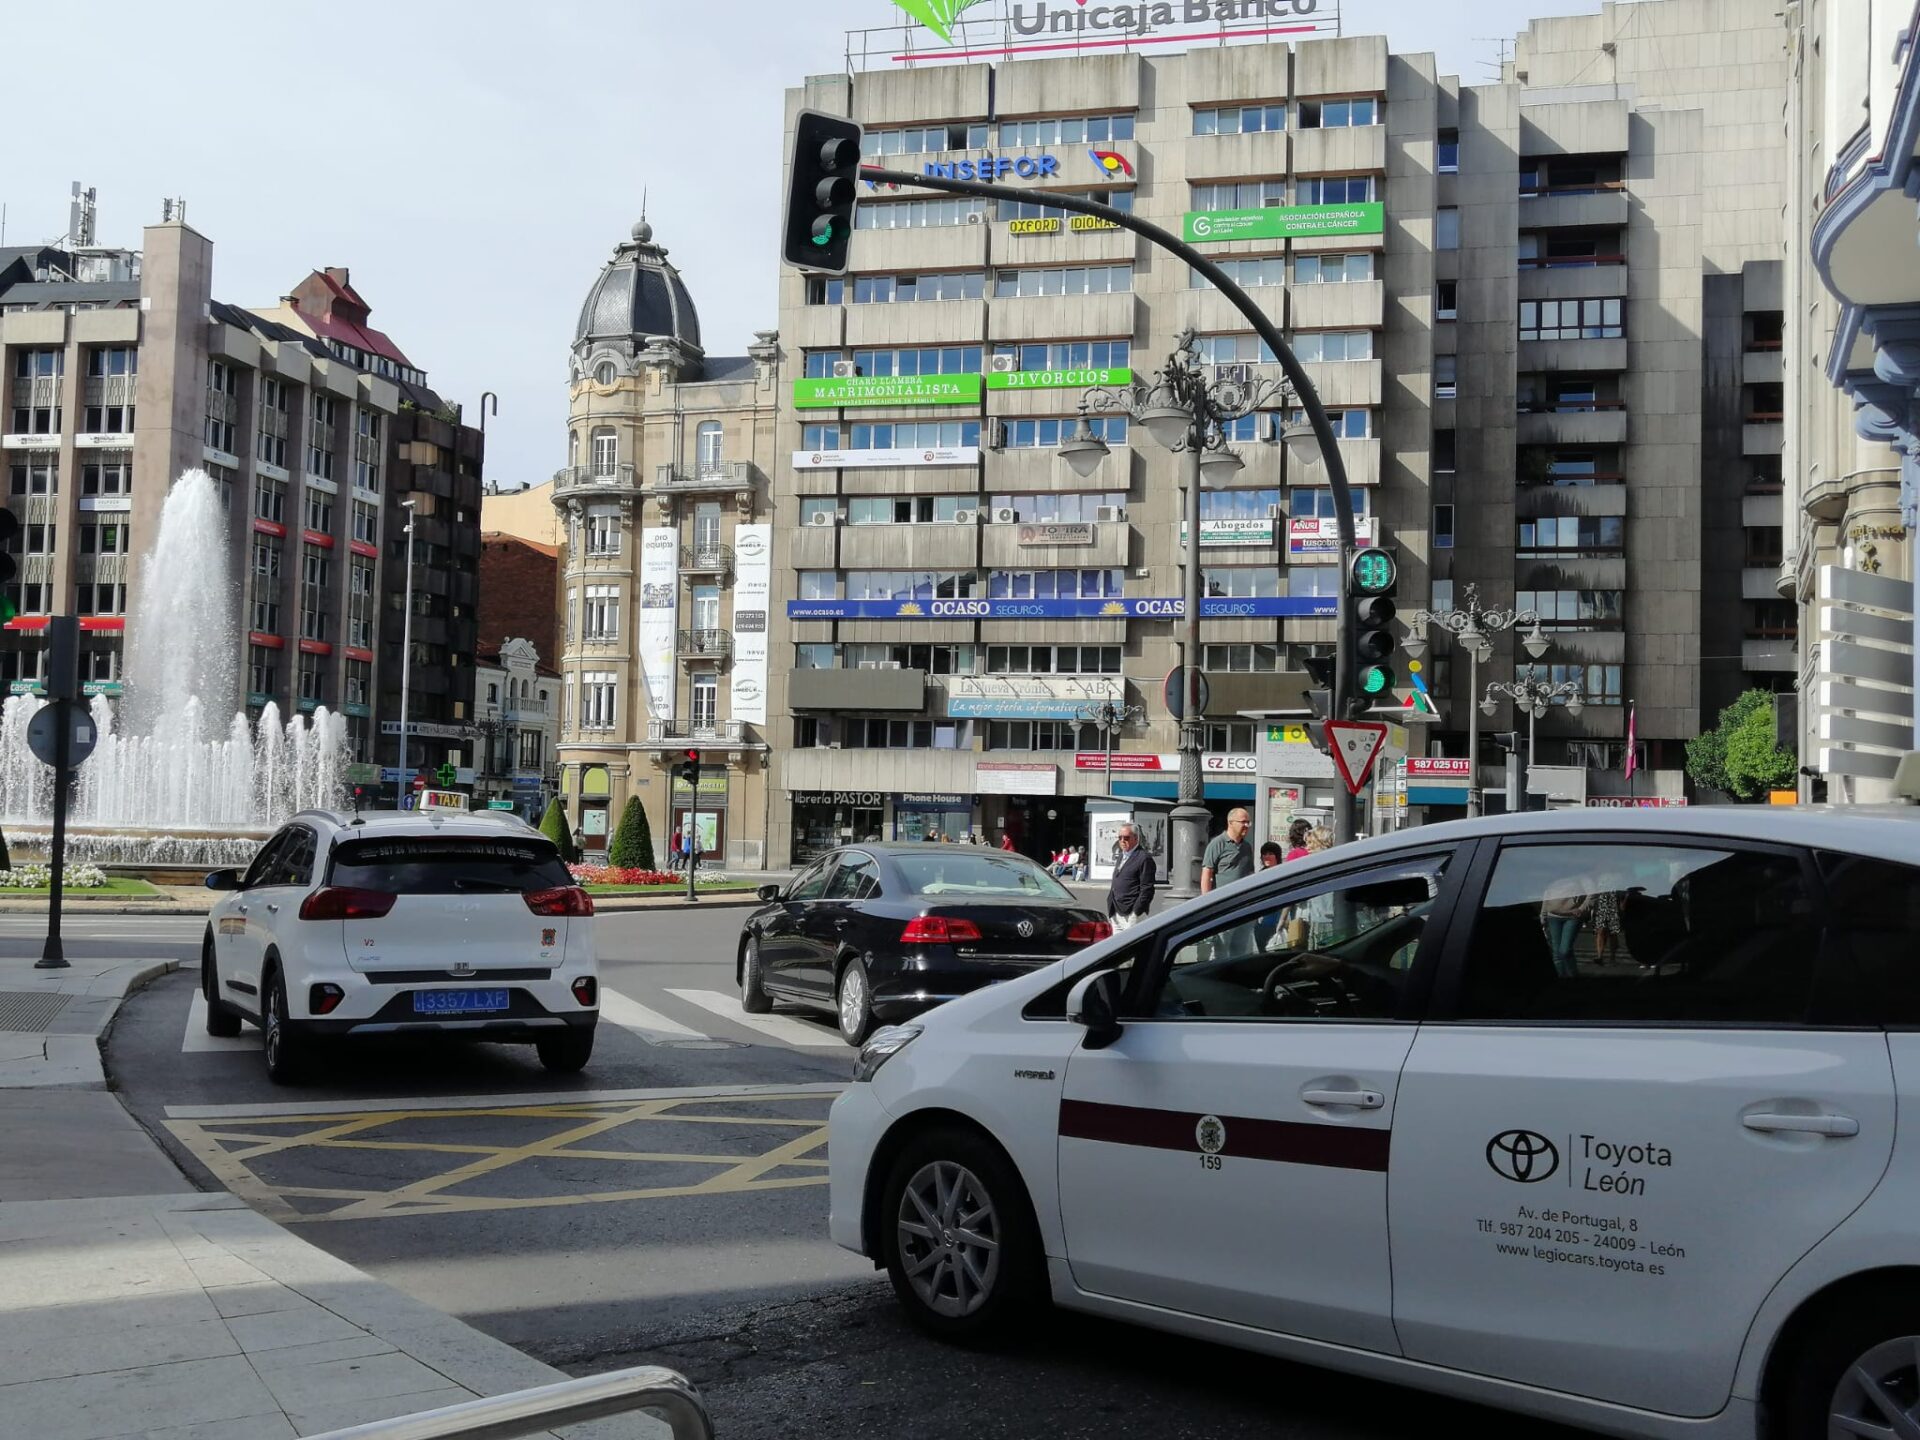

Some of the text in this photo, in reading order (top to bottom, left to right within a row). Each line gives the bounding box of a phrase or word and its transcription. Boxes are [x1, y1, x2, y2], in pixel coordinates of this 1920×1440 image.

[1013, 0, 1317, 36] Unicaja Banco
[924, 155, 1058, 180] INSEFOR
[1279, 210, 1365, 222] ASOCIACIÓN ESPAÑOLA
[1009, 218, 1059, 232] OXFORD
[1285, 222, 1317, 230] CONTRA
[1327, 220, 1358, 228] CÁNCER
[846, 376, 922, 387] CHARO LLAMERA
[1007, 371, 1110, 386] DIVORCIOS
[815, 383, 961, 398] MATRIMONIALISTA
[1213, 521, 1264, 532] Abogados
[792, 601, 1044, 616] www.ocaso.es OCASO SEGUROS
[1135, 600, 1185, 615] OCAS
[1204, 603, 1256, 614] SEGUROS
[10, 683, 33, 692] caser
[83, 683, 106, 693] caser
[960, 682, 973, 692] La
[976, 681, 1009, 693] Nueva
[1085, 682, 1118, 695] ABC
[952, 700, 965, 712] La
[969, 703, 993, 716] mejor
[995, 700, 1023, 714] oferta
[1414, 760, 1469, 769] 987 025 011
[438, 793, 461, 807] TAXI
[794, 792, 881, 805] librería PASTOR
[903, 794, 962, 803] Phone House
[364, 938, 375, 947] V2
[474, 991, 505, 1007] LXF
[1580, 1135, 1672, 1167] Toyota
[1200, 1155, 1222, 1170] 159
[1584, 1167, 1646, 1196] León
[1518, 1206, 1638, 1232] Av. de Portugal, 8
[1477, 1219, 1496, 1233] Tlf.
[1500, 1222, 1523, 1237] 987
[1527, 1226, 1552, 1240] 204
[1555, 1229, 1580, 1244] 205
[1593, 1233, 1636, 1251] 24009
[1650, 1241, 1685, 1258] León
